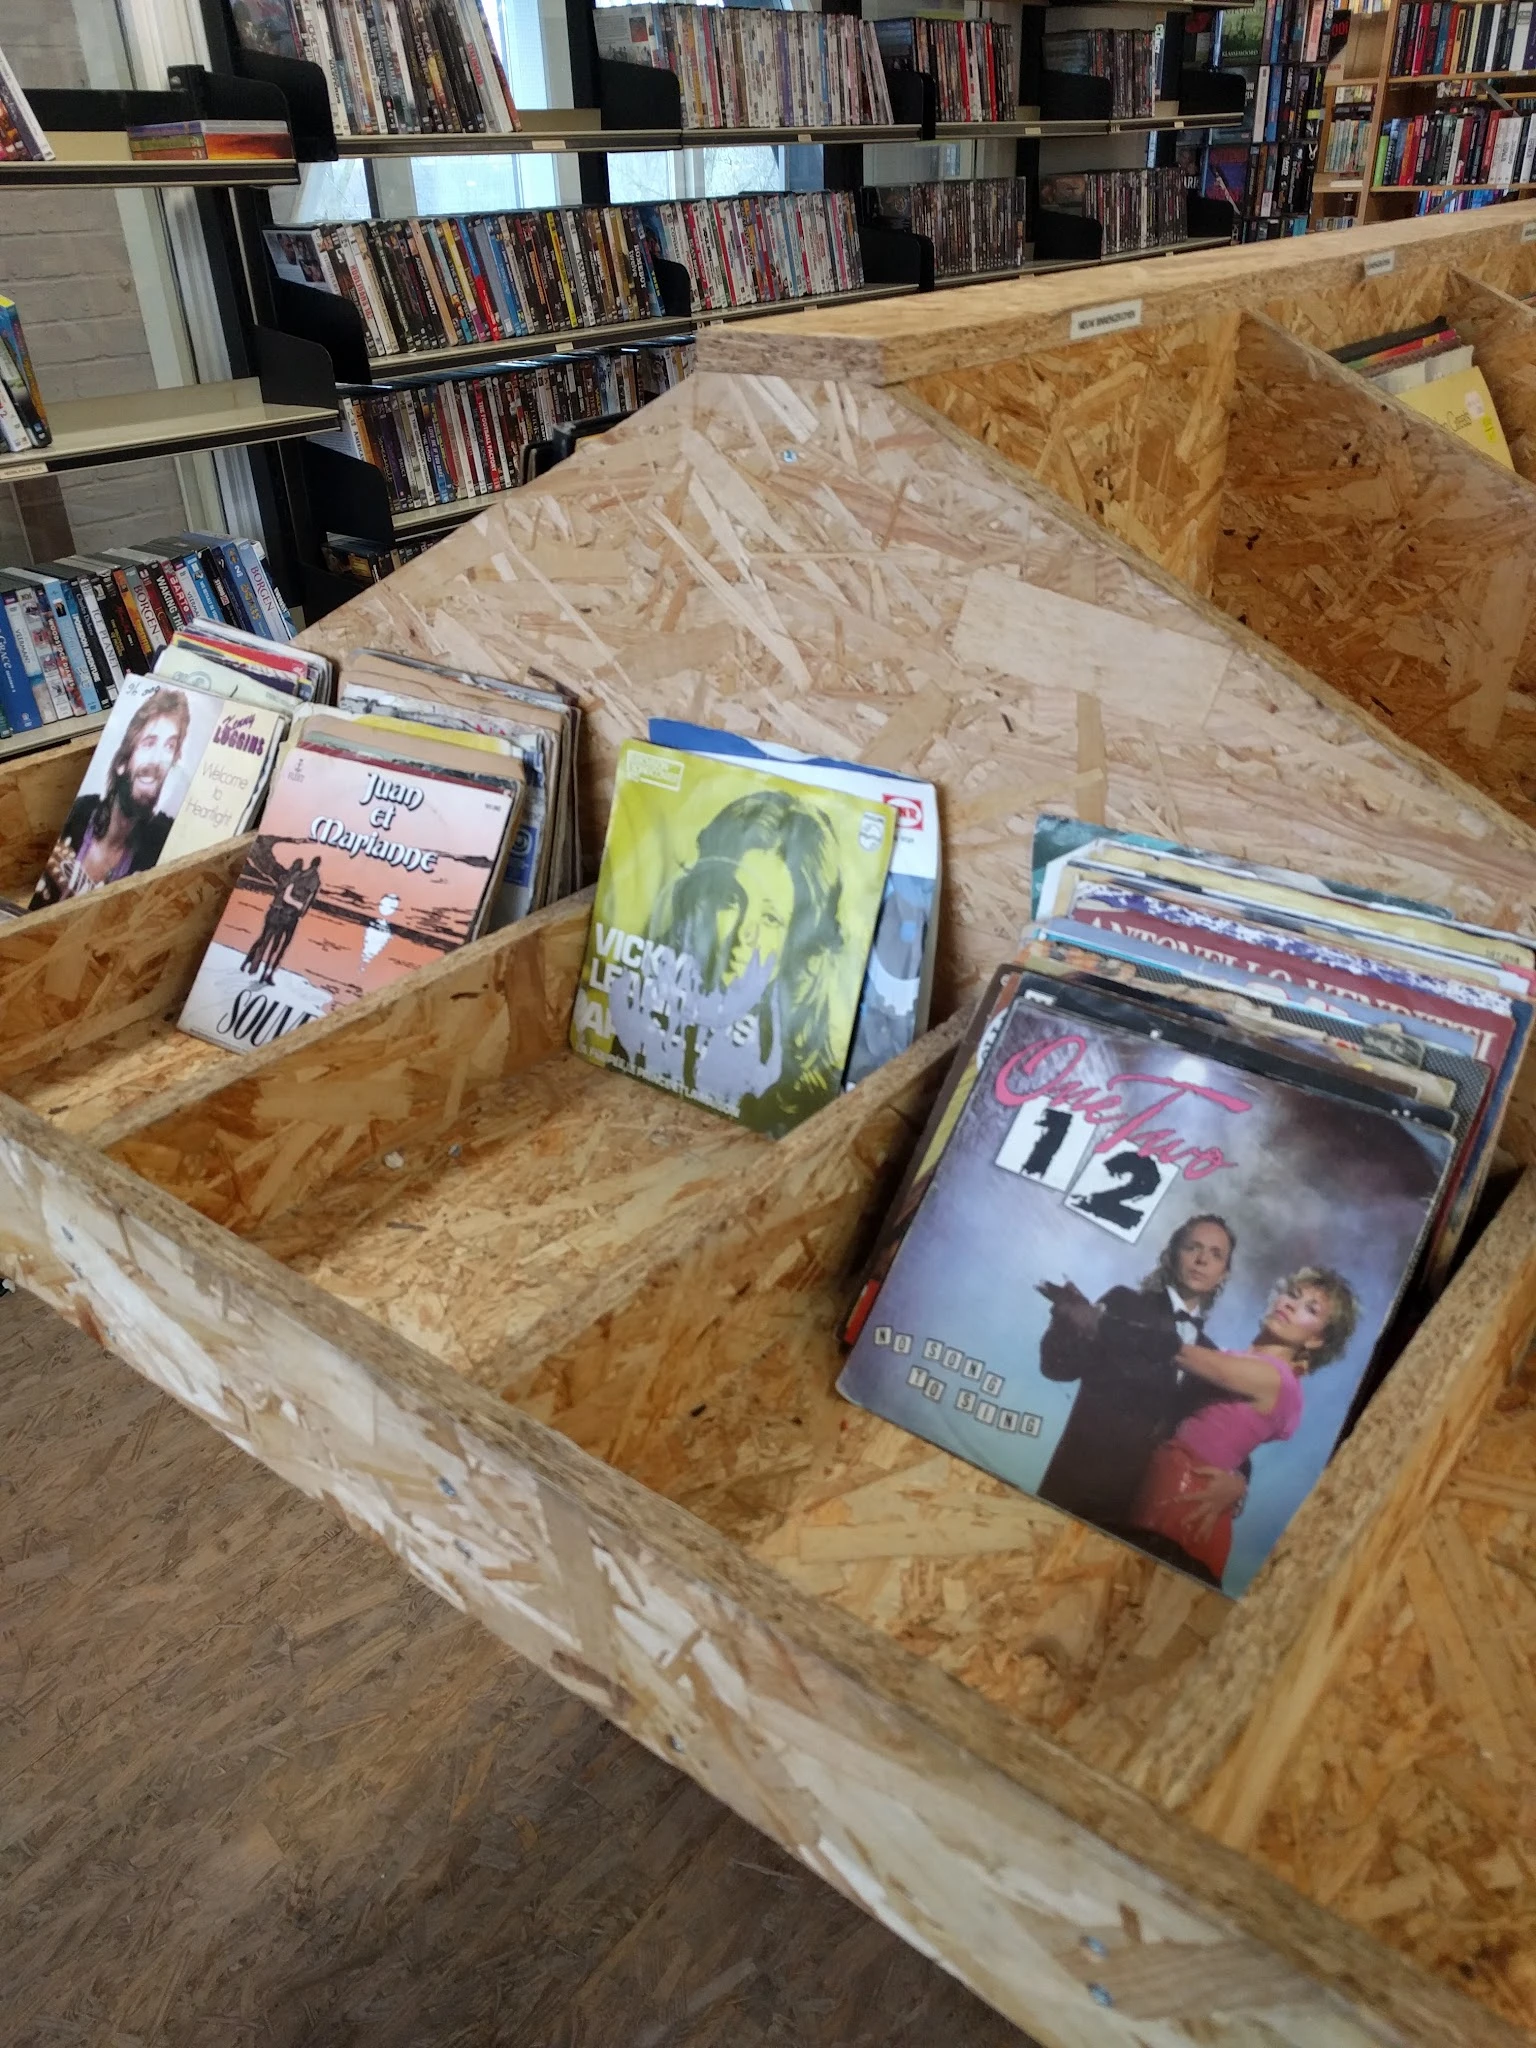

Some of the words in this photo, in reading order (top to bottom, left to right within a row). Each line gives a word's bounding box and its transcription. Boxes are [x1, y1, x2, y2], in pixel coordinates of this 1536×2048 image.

[577, 256, 585, 274] AM
[581, 276, 590, 297] SAM
[634, 244, 647, 288] HOMEBOY
[481, 414, 491, 445] FOOTBALL
[488, 446, 496, 472] FACTORY
[133, 584, 161, 636] BORGEN
[156, 575, 178, 614] WAKING
[251, 565, 275, 612] BORGEN
[47, 619, 67, 662] WOODSTOCK
[62, 662, 75, 687] DIARIES
[91, 608, 104, 626] ICE
[99, 629, 119, 670] PLANET
[84, 647, 101, 683] ADVENTURE
[202, 761, 249, 791] Welcome
[213, 787, 224, 802] to
[358, 771, 425, 812] Juan
[369, 804, 397, 832] et
[309, 815, 440, 873] Marianne
[994, 1035, 1129, 1125] One
[1093, 1073, 1254, 1181] Two
[876, 1326, 912, 1354] NO
[925, 1340, 1003, 1396] SONG
[909, 1366, 946, 1402] TO
[957, 1390, 1041, 1437] SING
